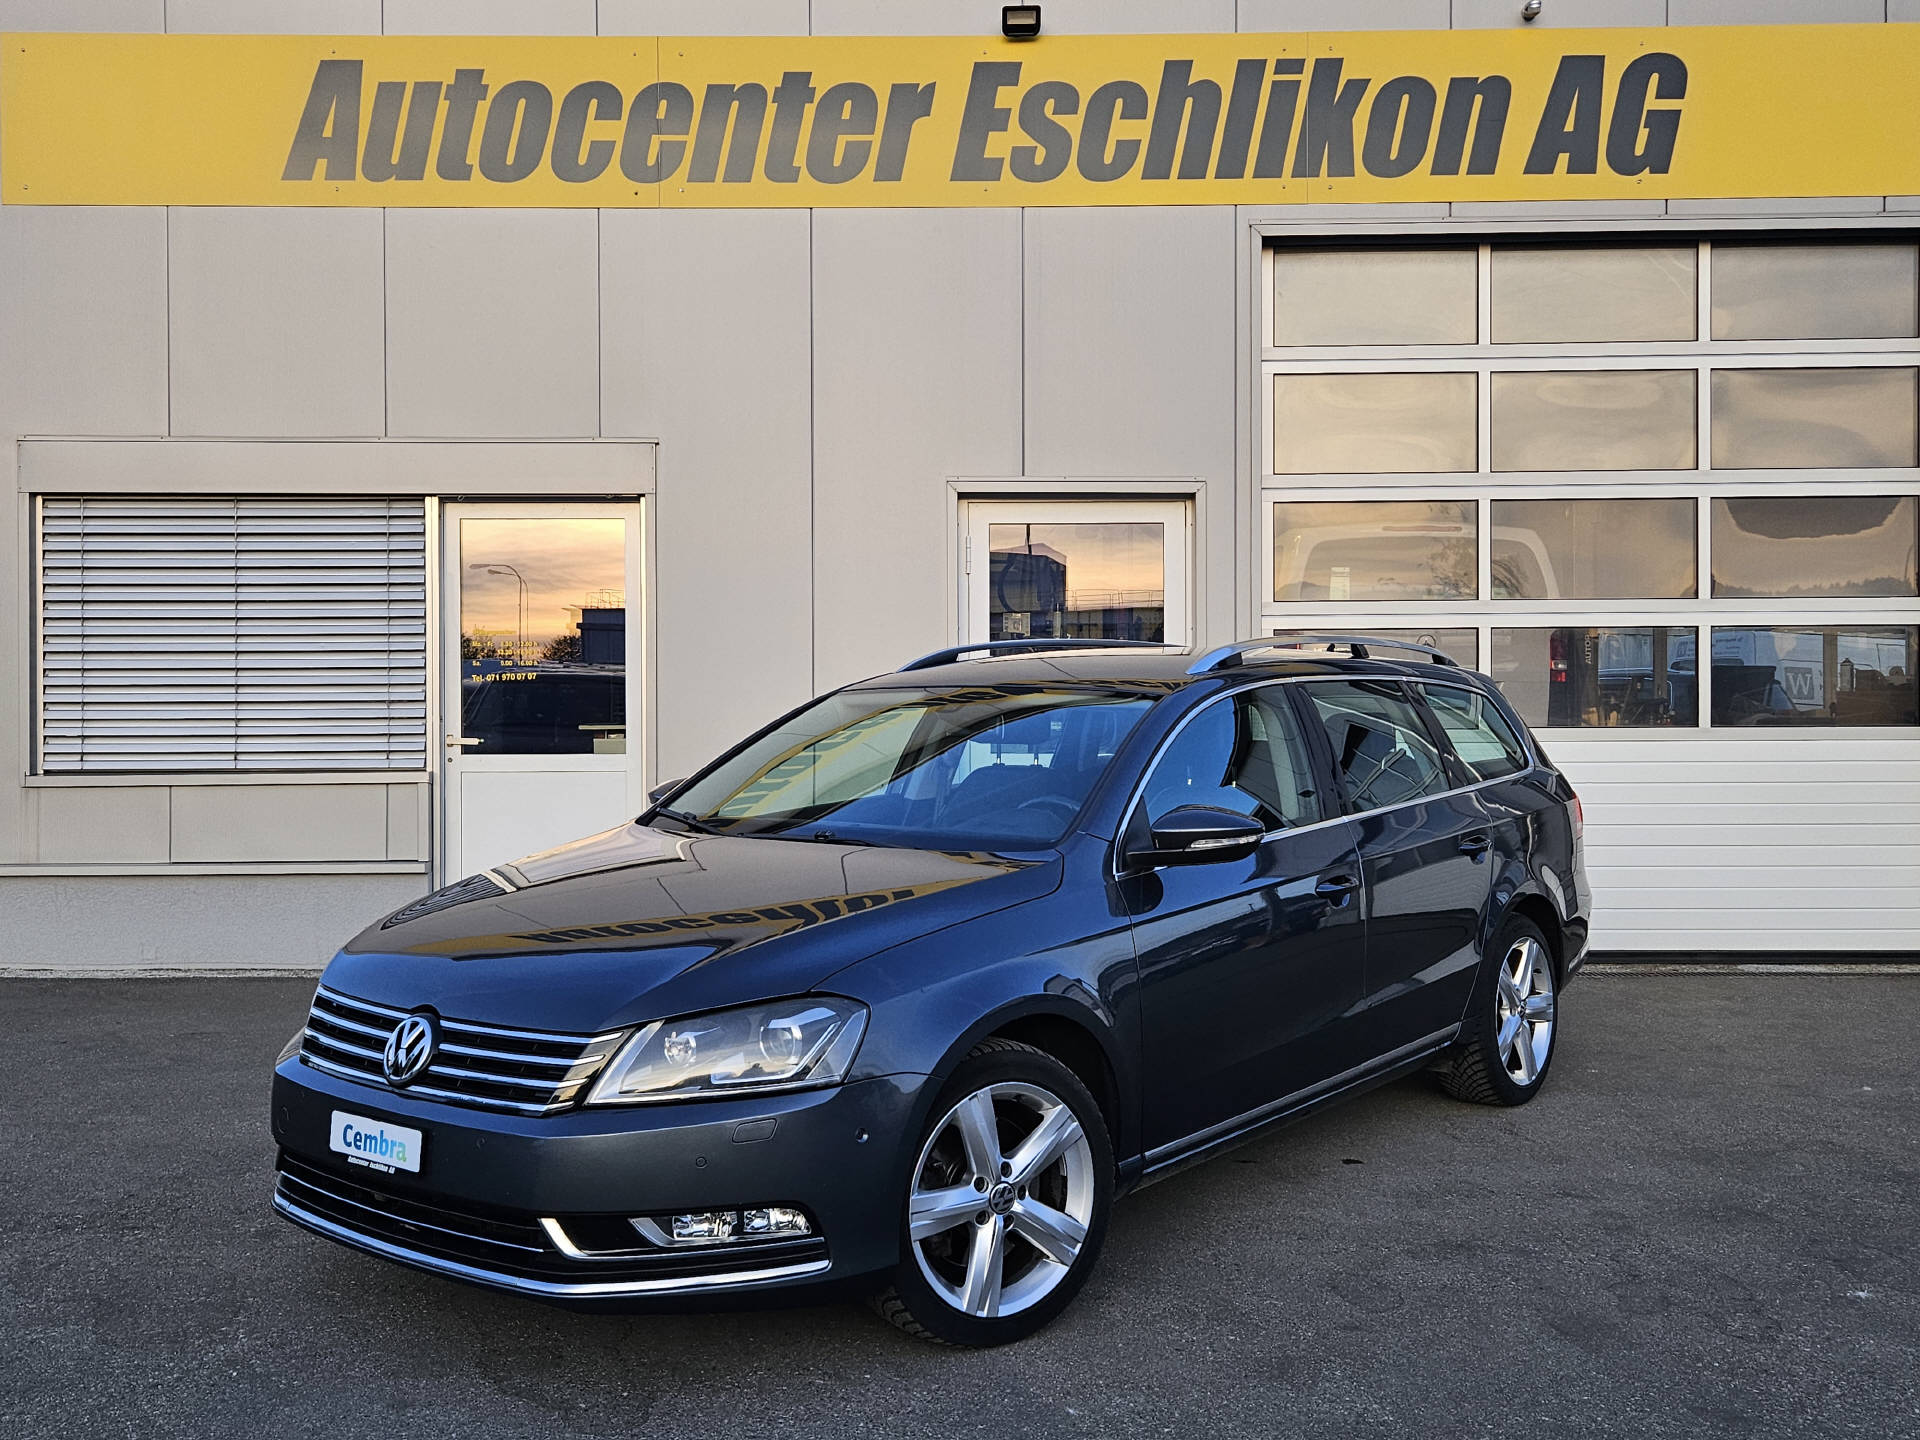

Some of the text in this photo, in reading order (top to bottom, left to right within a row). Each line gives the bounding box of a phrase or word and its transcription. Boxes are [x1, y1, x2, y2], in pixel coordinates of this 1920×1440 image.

[281, 52, 1688, 184] Autocenter Eschlikon AG
[486, 674, 499, 682] 071
[501, 673, 515, 681] 970
[527, 672, 537, 680] 07
[343, 1124, 406, 1162] Cembra
